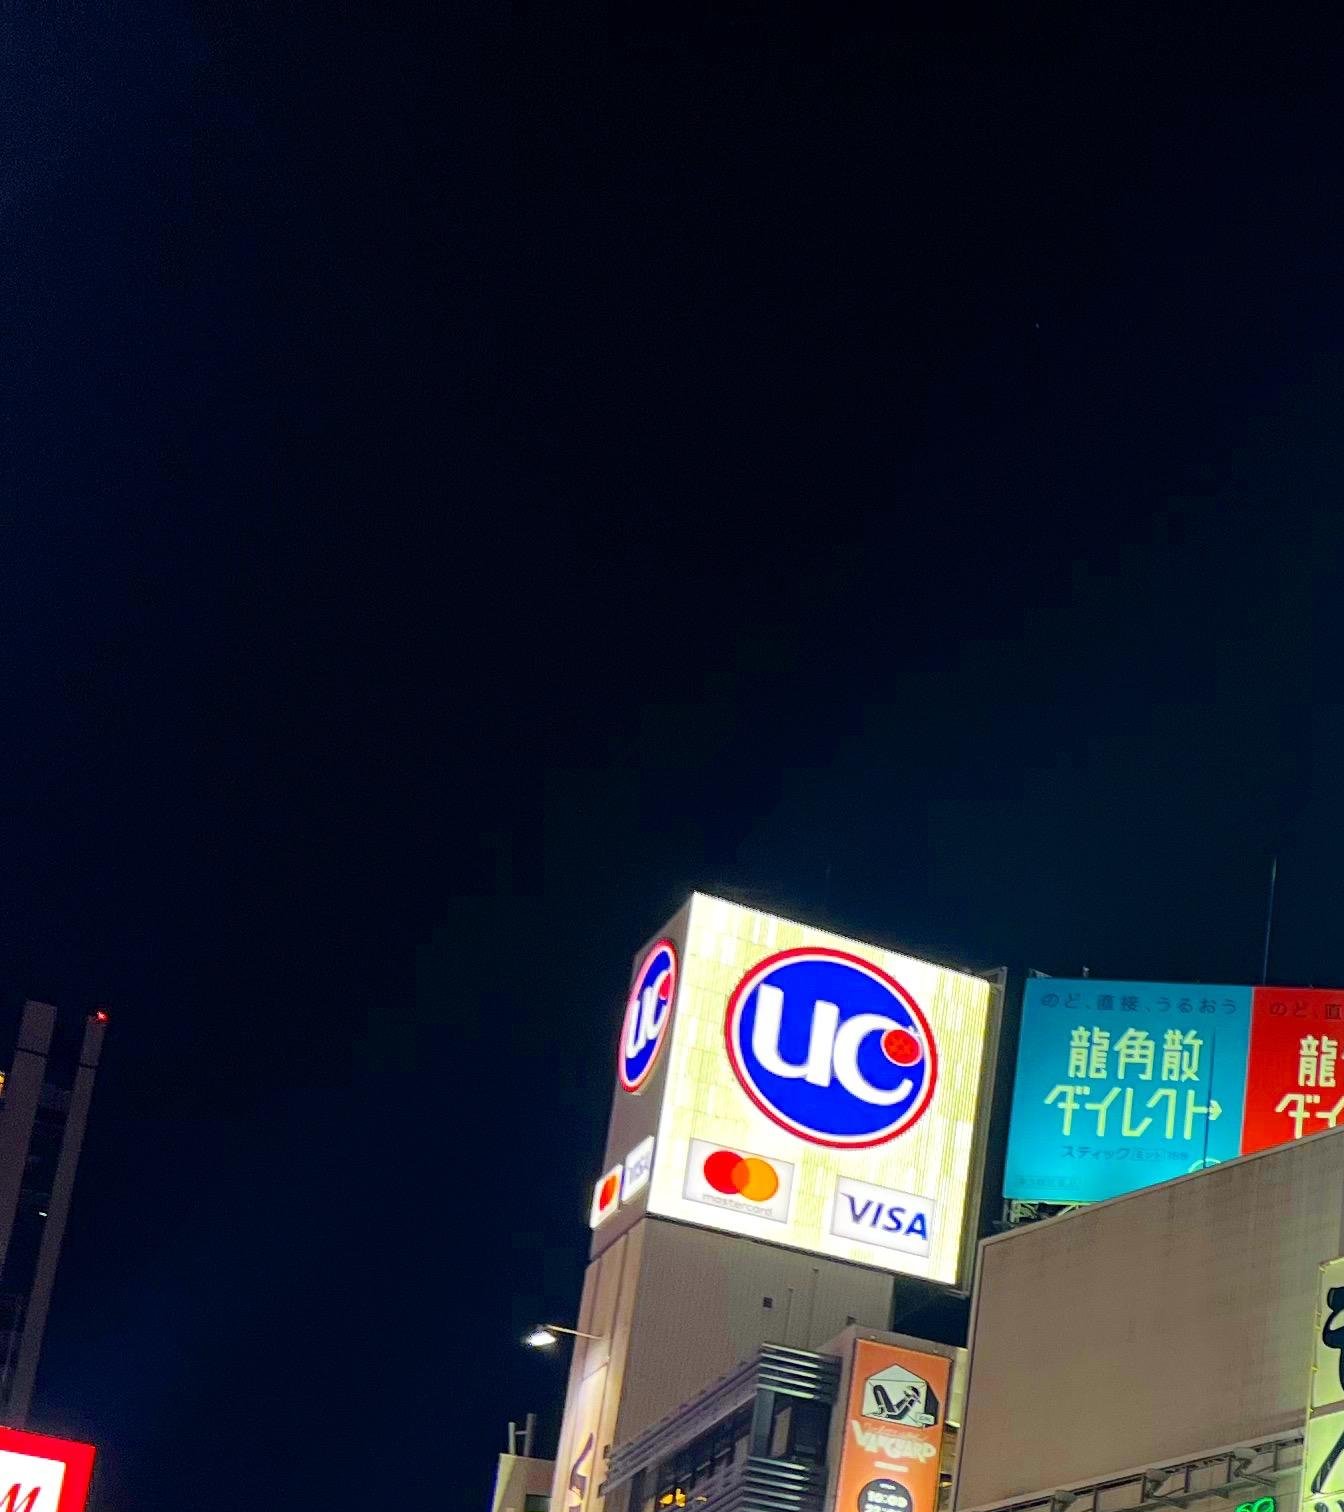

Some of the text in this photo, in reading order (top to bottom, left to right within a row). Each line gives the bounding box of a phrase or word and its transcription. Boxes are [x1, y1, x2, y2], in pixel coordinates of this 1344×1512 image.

[752, 984, 913, 1106] UC
[1068, 1025, 1203, 1083] 龍角散
[1044, 1084, 1223, 1140] ダイレクト
[702, 1193, 773, 1216] mastercard
[842, 1193, 927, 1240] VISA
